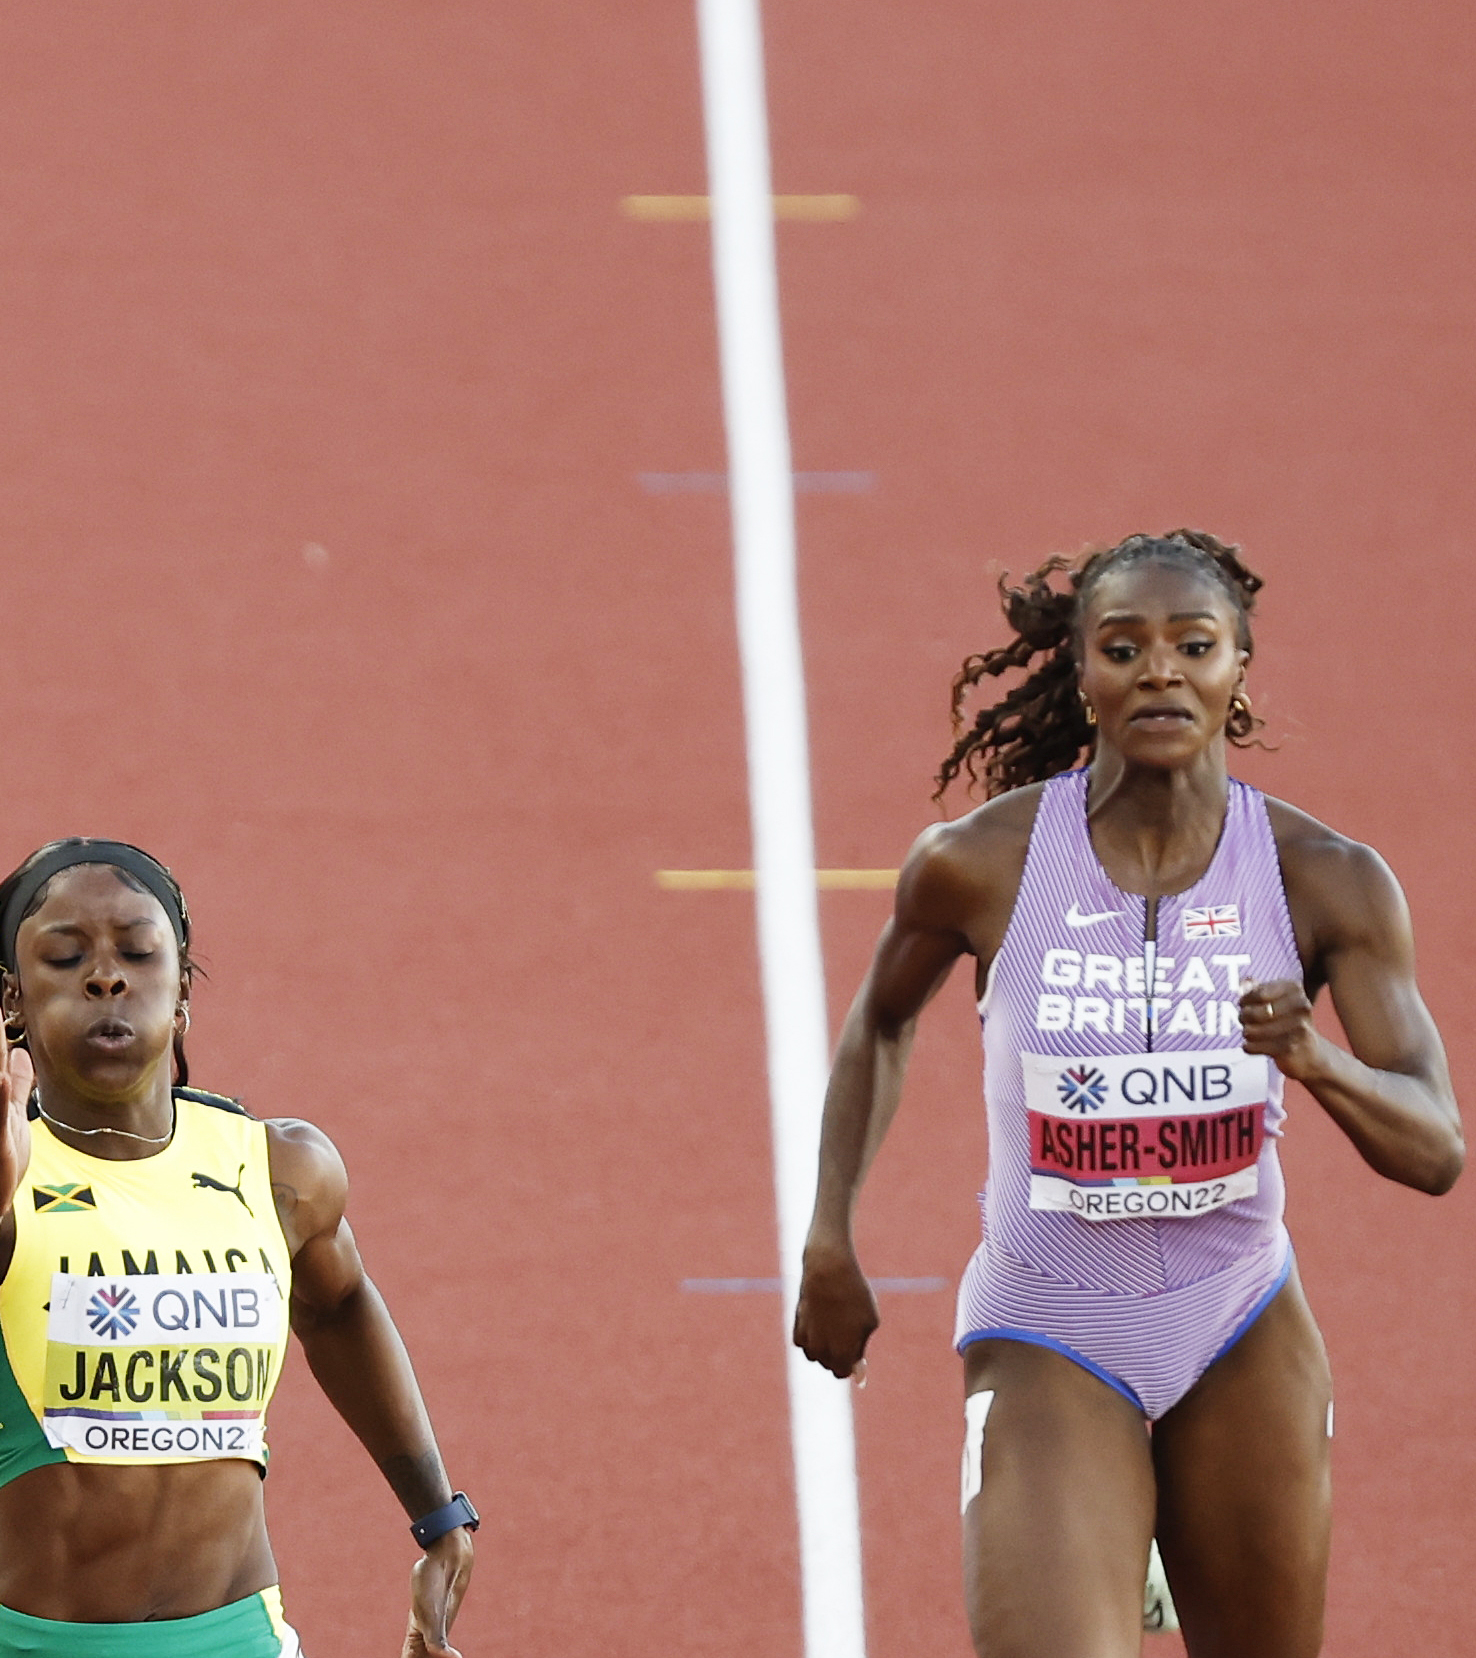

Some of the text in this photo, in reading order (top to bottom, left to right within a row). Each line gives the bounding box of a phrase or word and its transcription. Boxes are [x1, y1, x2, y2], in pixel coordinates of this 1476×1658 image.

[1042, 948, 1252, 995] GREAT
[1121, 1064, 1232, 1105] QNB
[1040, 1110, 1255, 1172] ASHER-SMITH
[1069, 1182, 1227, 1214] OREGON22
[153, 1288, 260, 1331] QNB
[59, 1347, 271, 1403] JACKSON
[85, 1425, 250, 1451] OREGON2
